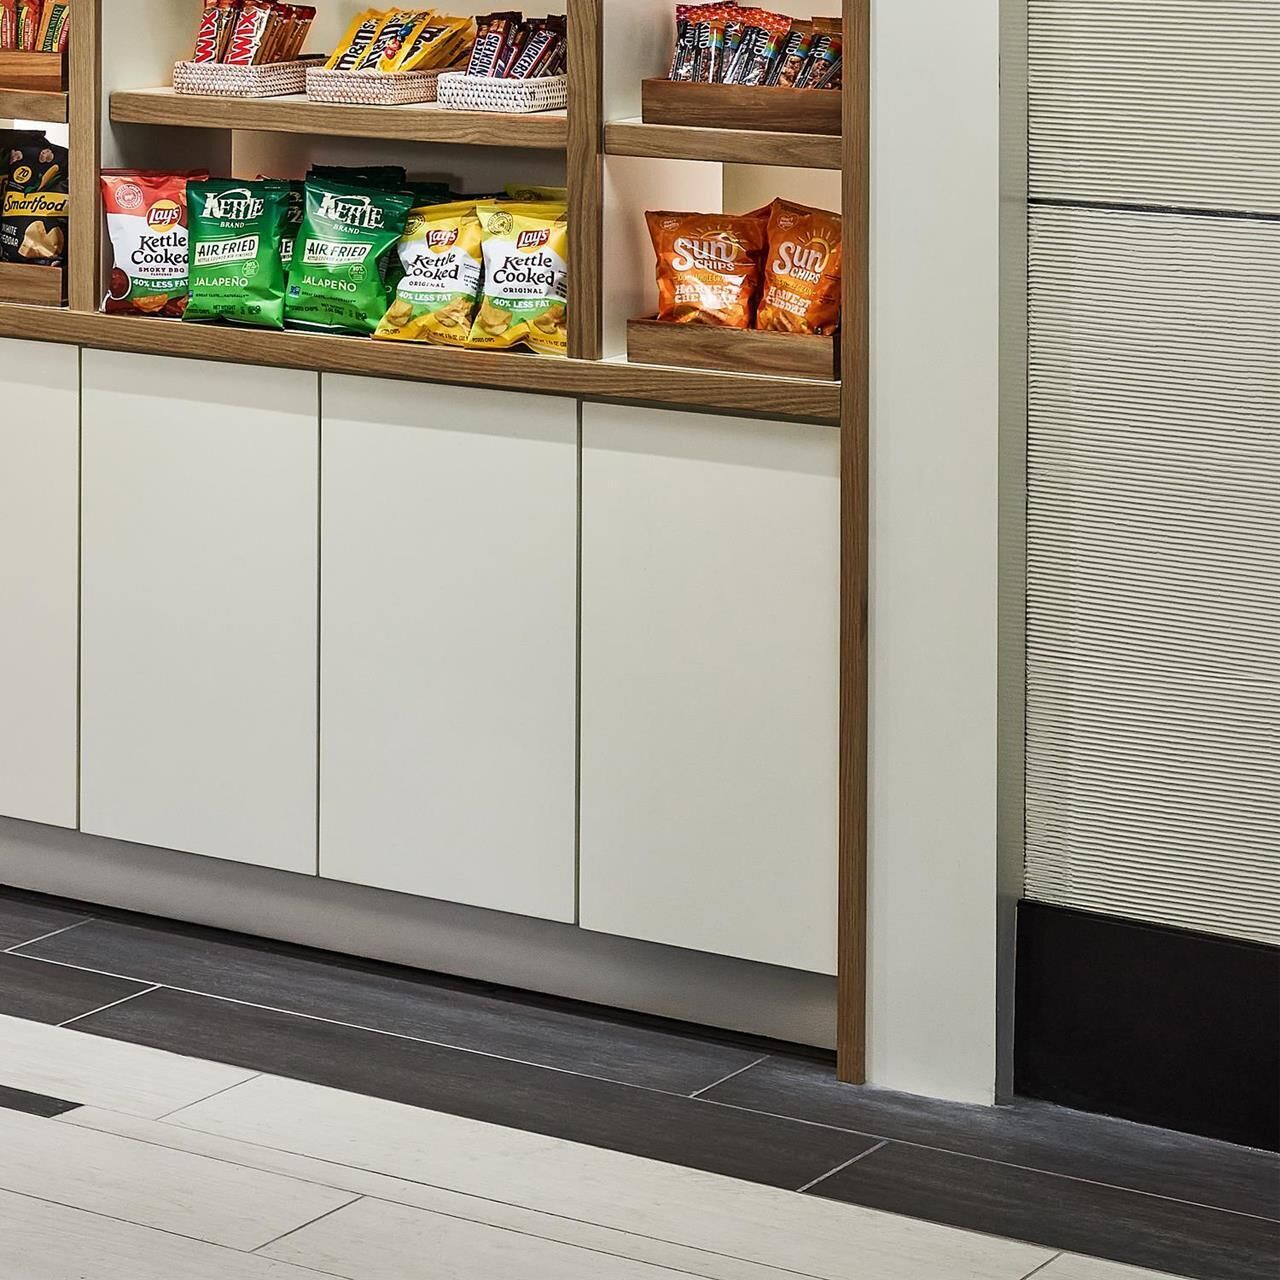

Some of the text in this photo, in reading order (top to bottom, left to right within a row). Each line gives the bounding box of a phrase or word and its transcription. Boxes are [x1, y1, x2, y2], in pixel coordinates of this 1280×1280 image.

[194, 9, 218, 64] WIX
[699, 22, 711, 49] KIND
[754, 29, 771, 56] KIND
[786, 31, 805, 55] KIND
[512, 32, 548, 80] SNICKERS
[814, 35, 833, 59] KIND
[18, 167, 29, 178] 70
[4, 193, 67, 214] Smartfood
[200, 187, 265, 220] KETTLE
[316, 191, 385, 229] KETTLE
[147, 205, 180, 226] Lay's
[332, 224, 361, 235] BRAND
[427, 228, 458, 247] Lay's
[519, 228, 549, 248] Lay's
[140, 232, 187, 252] Kettle
[197, 239, 256, 257] AIR FRIED
[306, 242, 367, 257] AIR FRIED
[415, 253, 456, 269] Kettle
[501, 252, 553, 270] Kettle
[671, 236, 735, 272] Sun
[772, 241, 825, 275] Sun
[405, 264, 459, 280] Cooked
[696, 259, 735, 271] CHIPS
[132, 279, 189, 288] 40% LESS FAT
[302, 274, 357, 292] JALAPEÑO
[492, 267, 555, 287] Cooked
[790, 268, 821, 285] CHIPS
[414, 293, 435, 301] LESS
[436, 294, 452, 302] FAT
[493, 298, 551, 308] 40% LESS FAT
[765, 296, 807, 317] CHEDDAR
[768, 286, 812, 308] HARVEST
